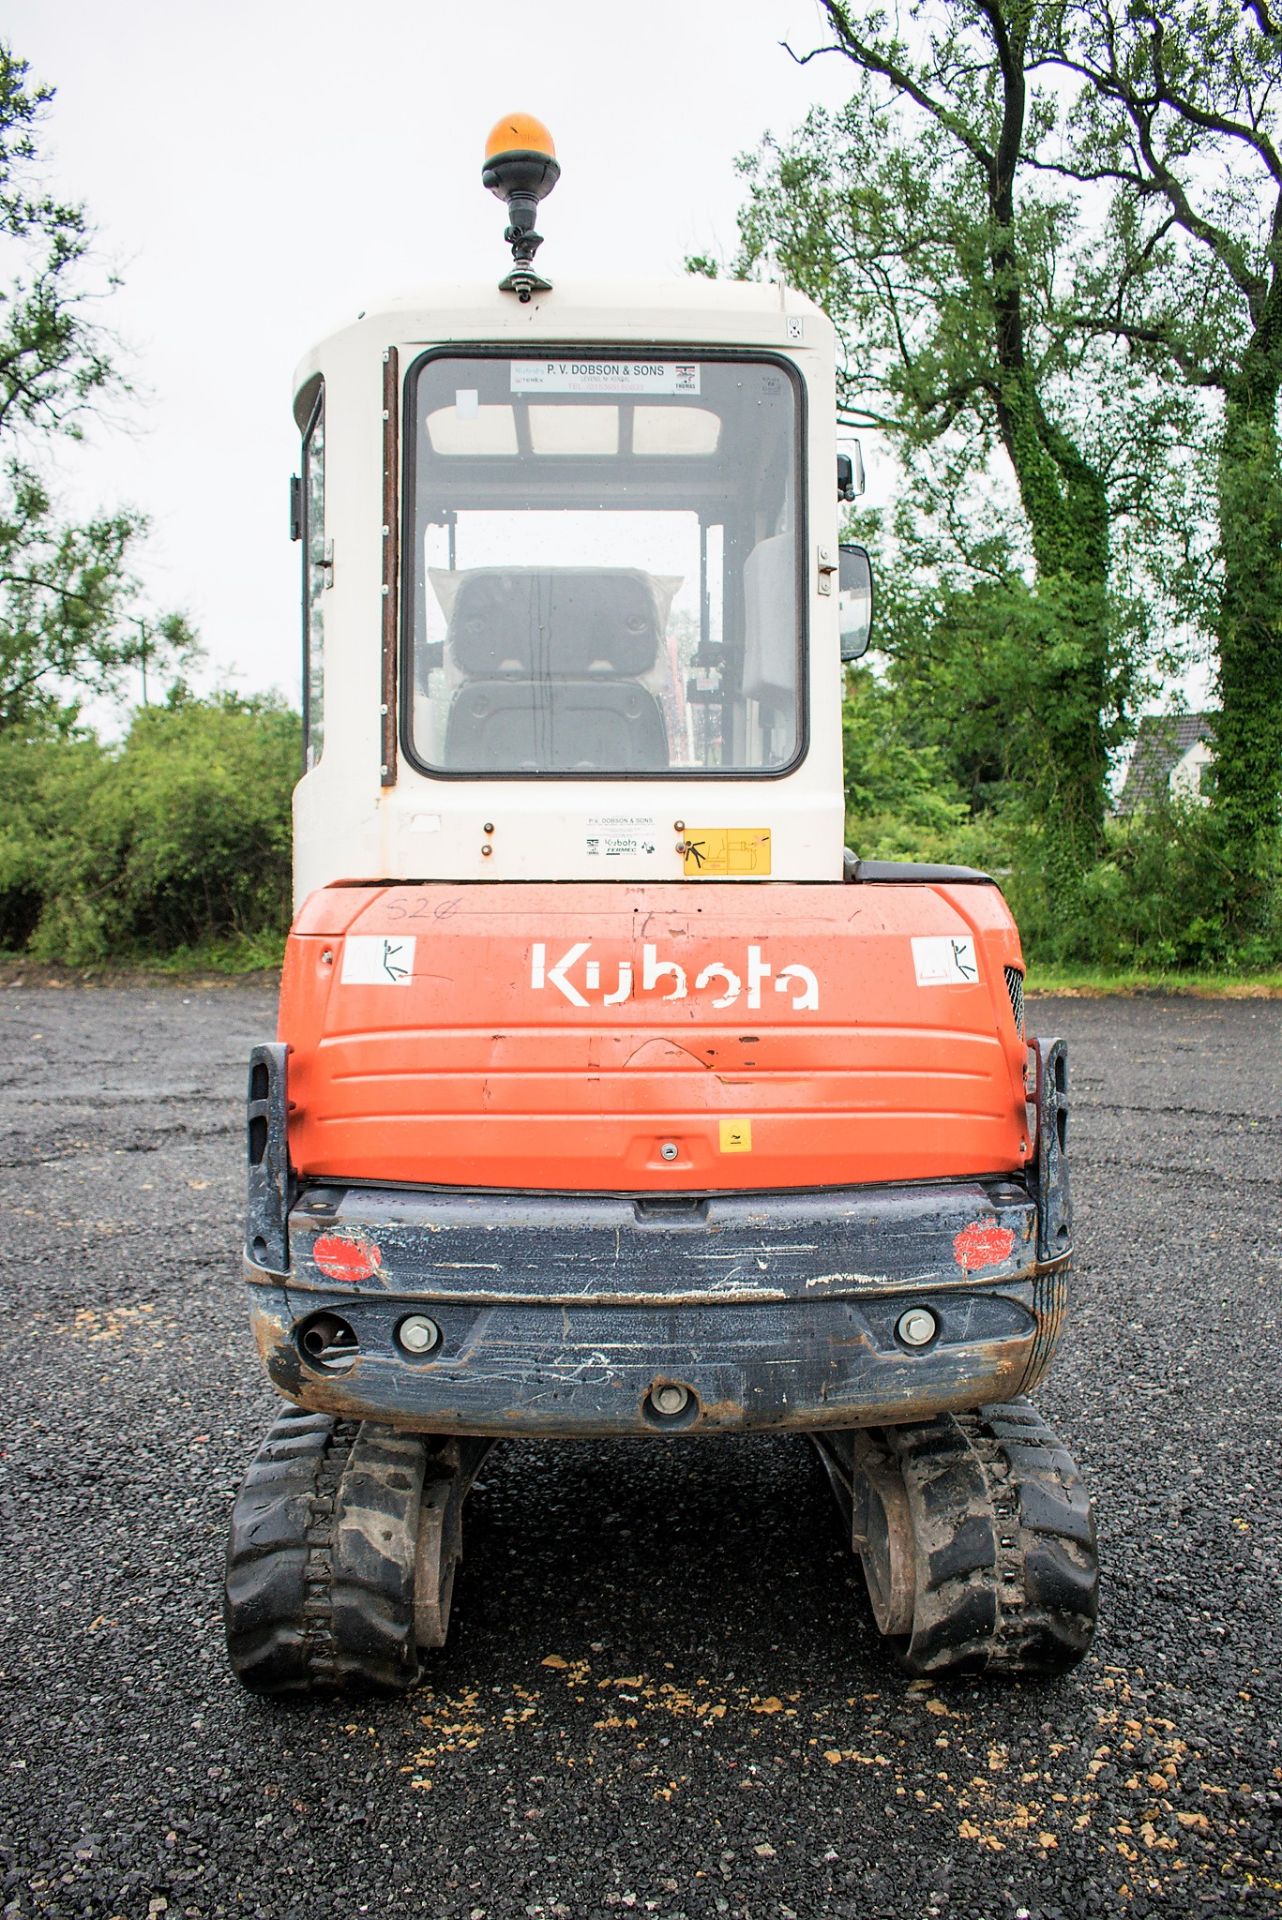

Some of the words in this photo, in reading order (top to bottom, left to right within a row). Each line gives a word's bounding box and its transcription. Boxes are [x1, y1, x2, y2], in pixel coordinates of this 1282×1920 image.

[547, 364, 556, 375] P.
[560, 364, 568, 375] V.
[571, 364, 619, 376] DOBSON
[623, 365, 630, 376] &
[633, 365, 665, 376] SONS
[531, 942, 819, 1011] Kubota
